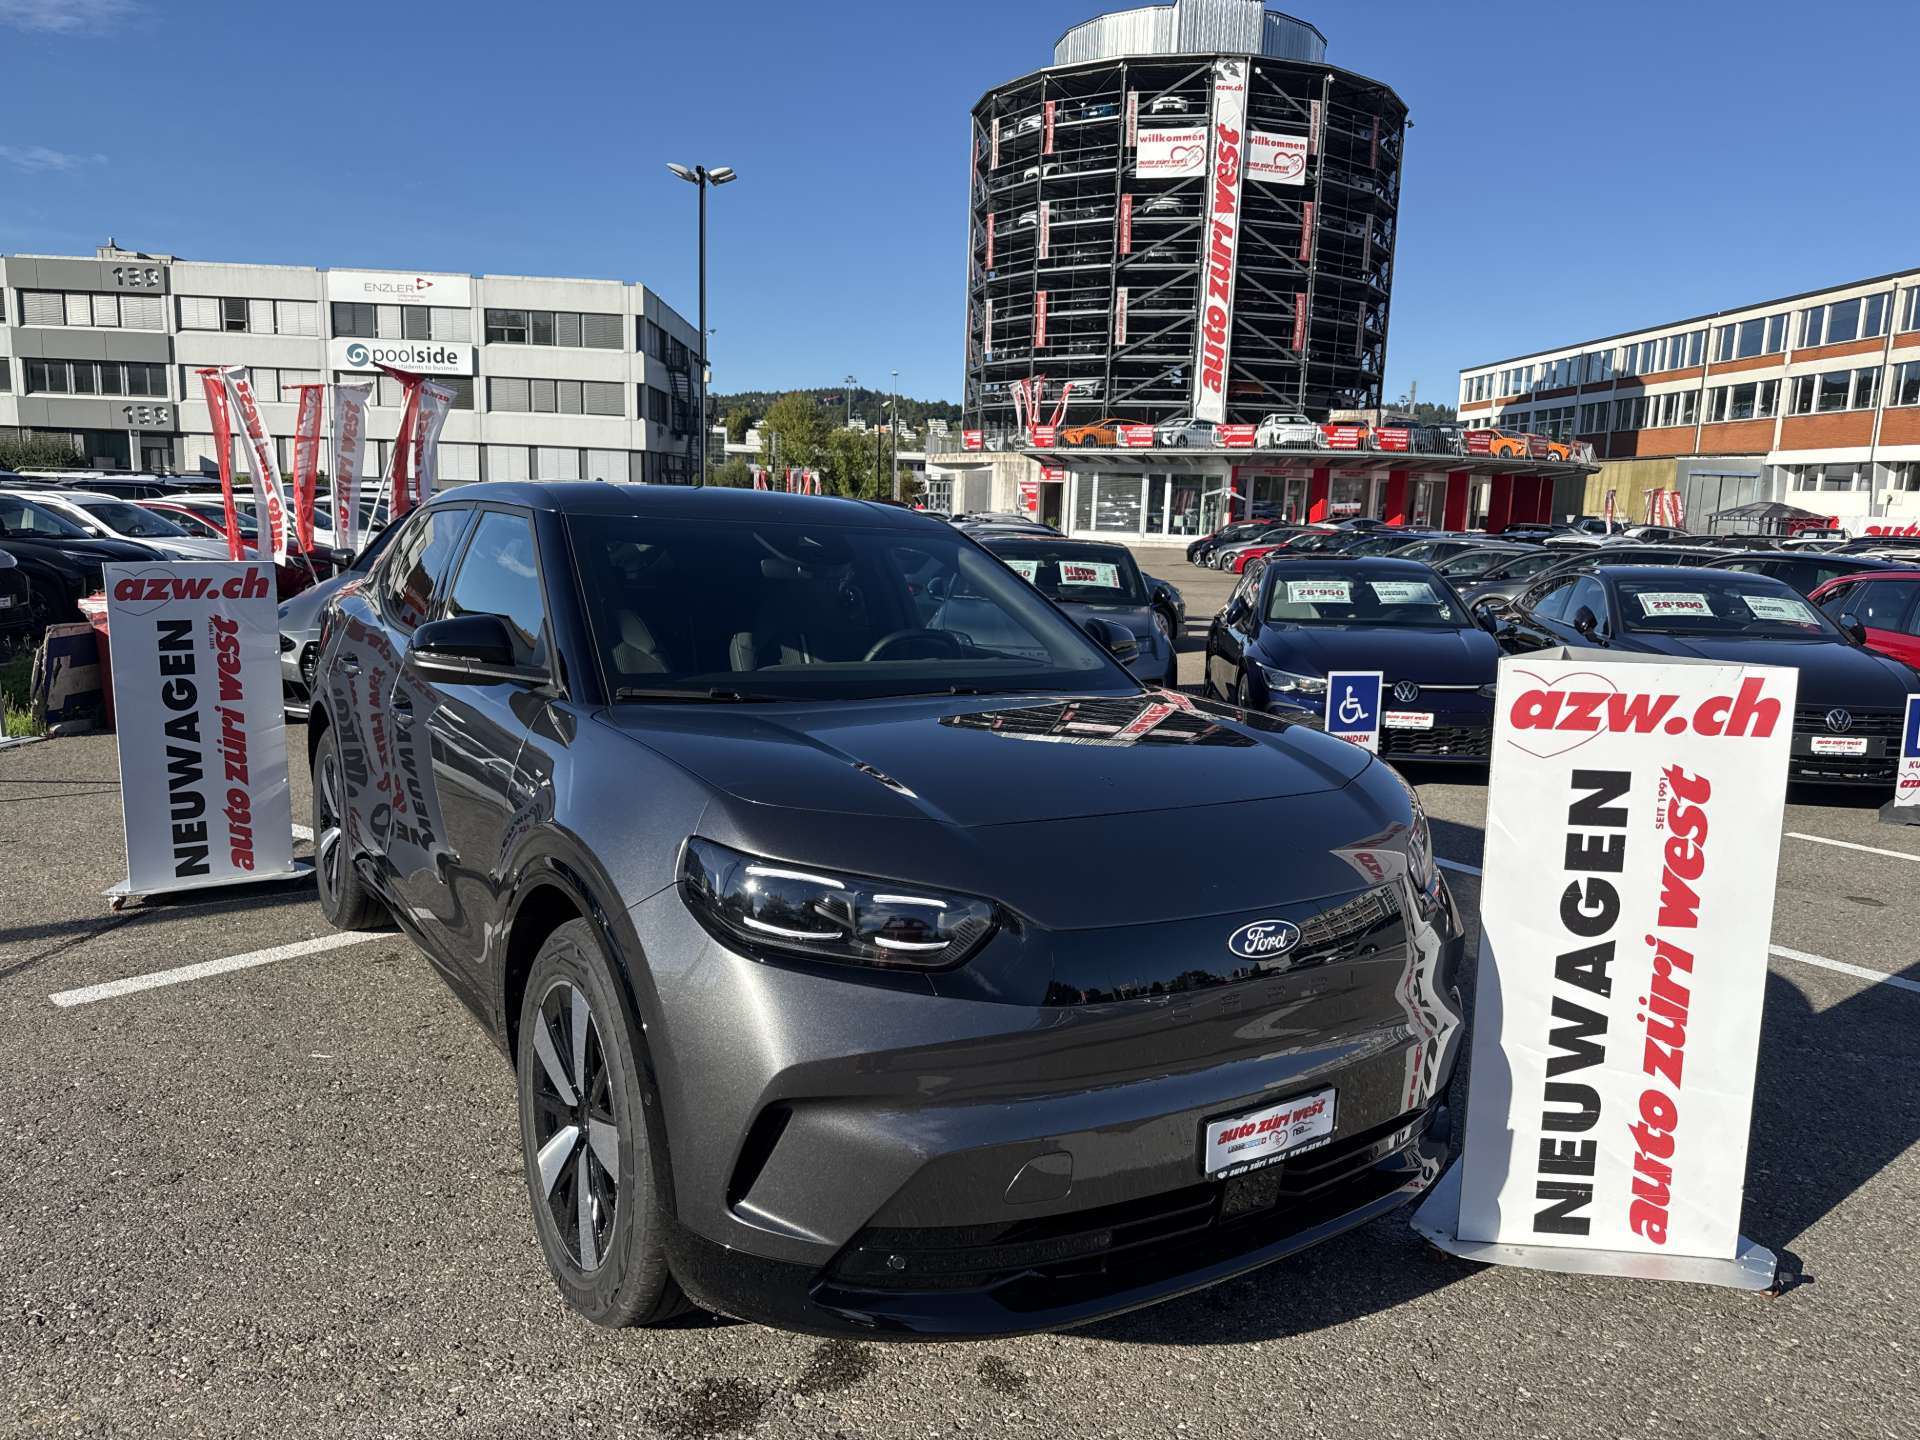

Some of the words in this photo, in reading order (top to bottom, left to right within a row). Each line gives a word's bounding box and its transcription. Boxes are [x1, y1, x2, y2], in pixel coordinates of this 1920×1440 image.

[1216, 83, 1243, 91] azw.ch
[1139, 133, 1205, 144] willkommen
[1247, 135, 1306, 151] willkommen
[1214, 122, 1239, 213] west
[112, 267, 159, 287] 139
[364, 282, 415, 294] ENZLER
[373, 345, 458, 365] poolside
[1202, 305, 1227, 394] auto
[122, 406, 169, 426] 139
[113, 566, 270, 602] azw.ch
[208, 613, 244, 701] west
[1509, 676, 1782, 738] azw.ch
[157, 619, 210, 878] NEUWAGEN
[214, 705, 250, 786] züri
[1657, 776, 1669, 803] 1991
[222, 787, 255, 872] auto
[1656, 806, 1666, 830] SEIT
[1657, 763, 1712, 929] west
[1244, 925, 1287, 952] Ford
[1532, 768, 1632, 1236] NEUWAGEN
[1637, 933, 1695, 1092] züri
[1217, 1122, 1256, 1146] auto
[1256, 1110, 1293, 1134] züri
[1292, 1097, 1326, 1122] west
[1228, 1165, 1248, 1177] auto
[1249, 1157, 1269, 1171] züri
[1268, 1152, 1287, 1165] west
[1627, 1088, 1679, 1246] auto
